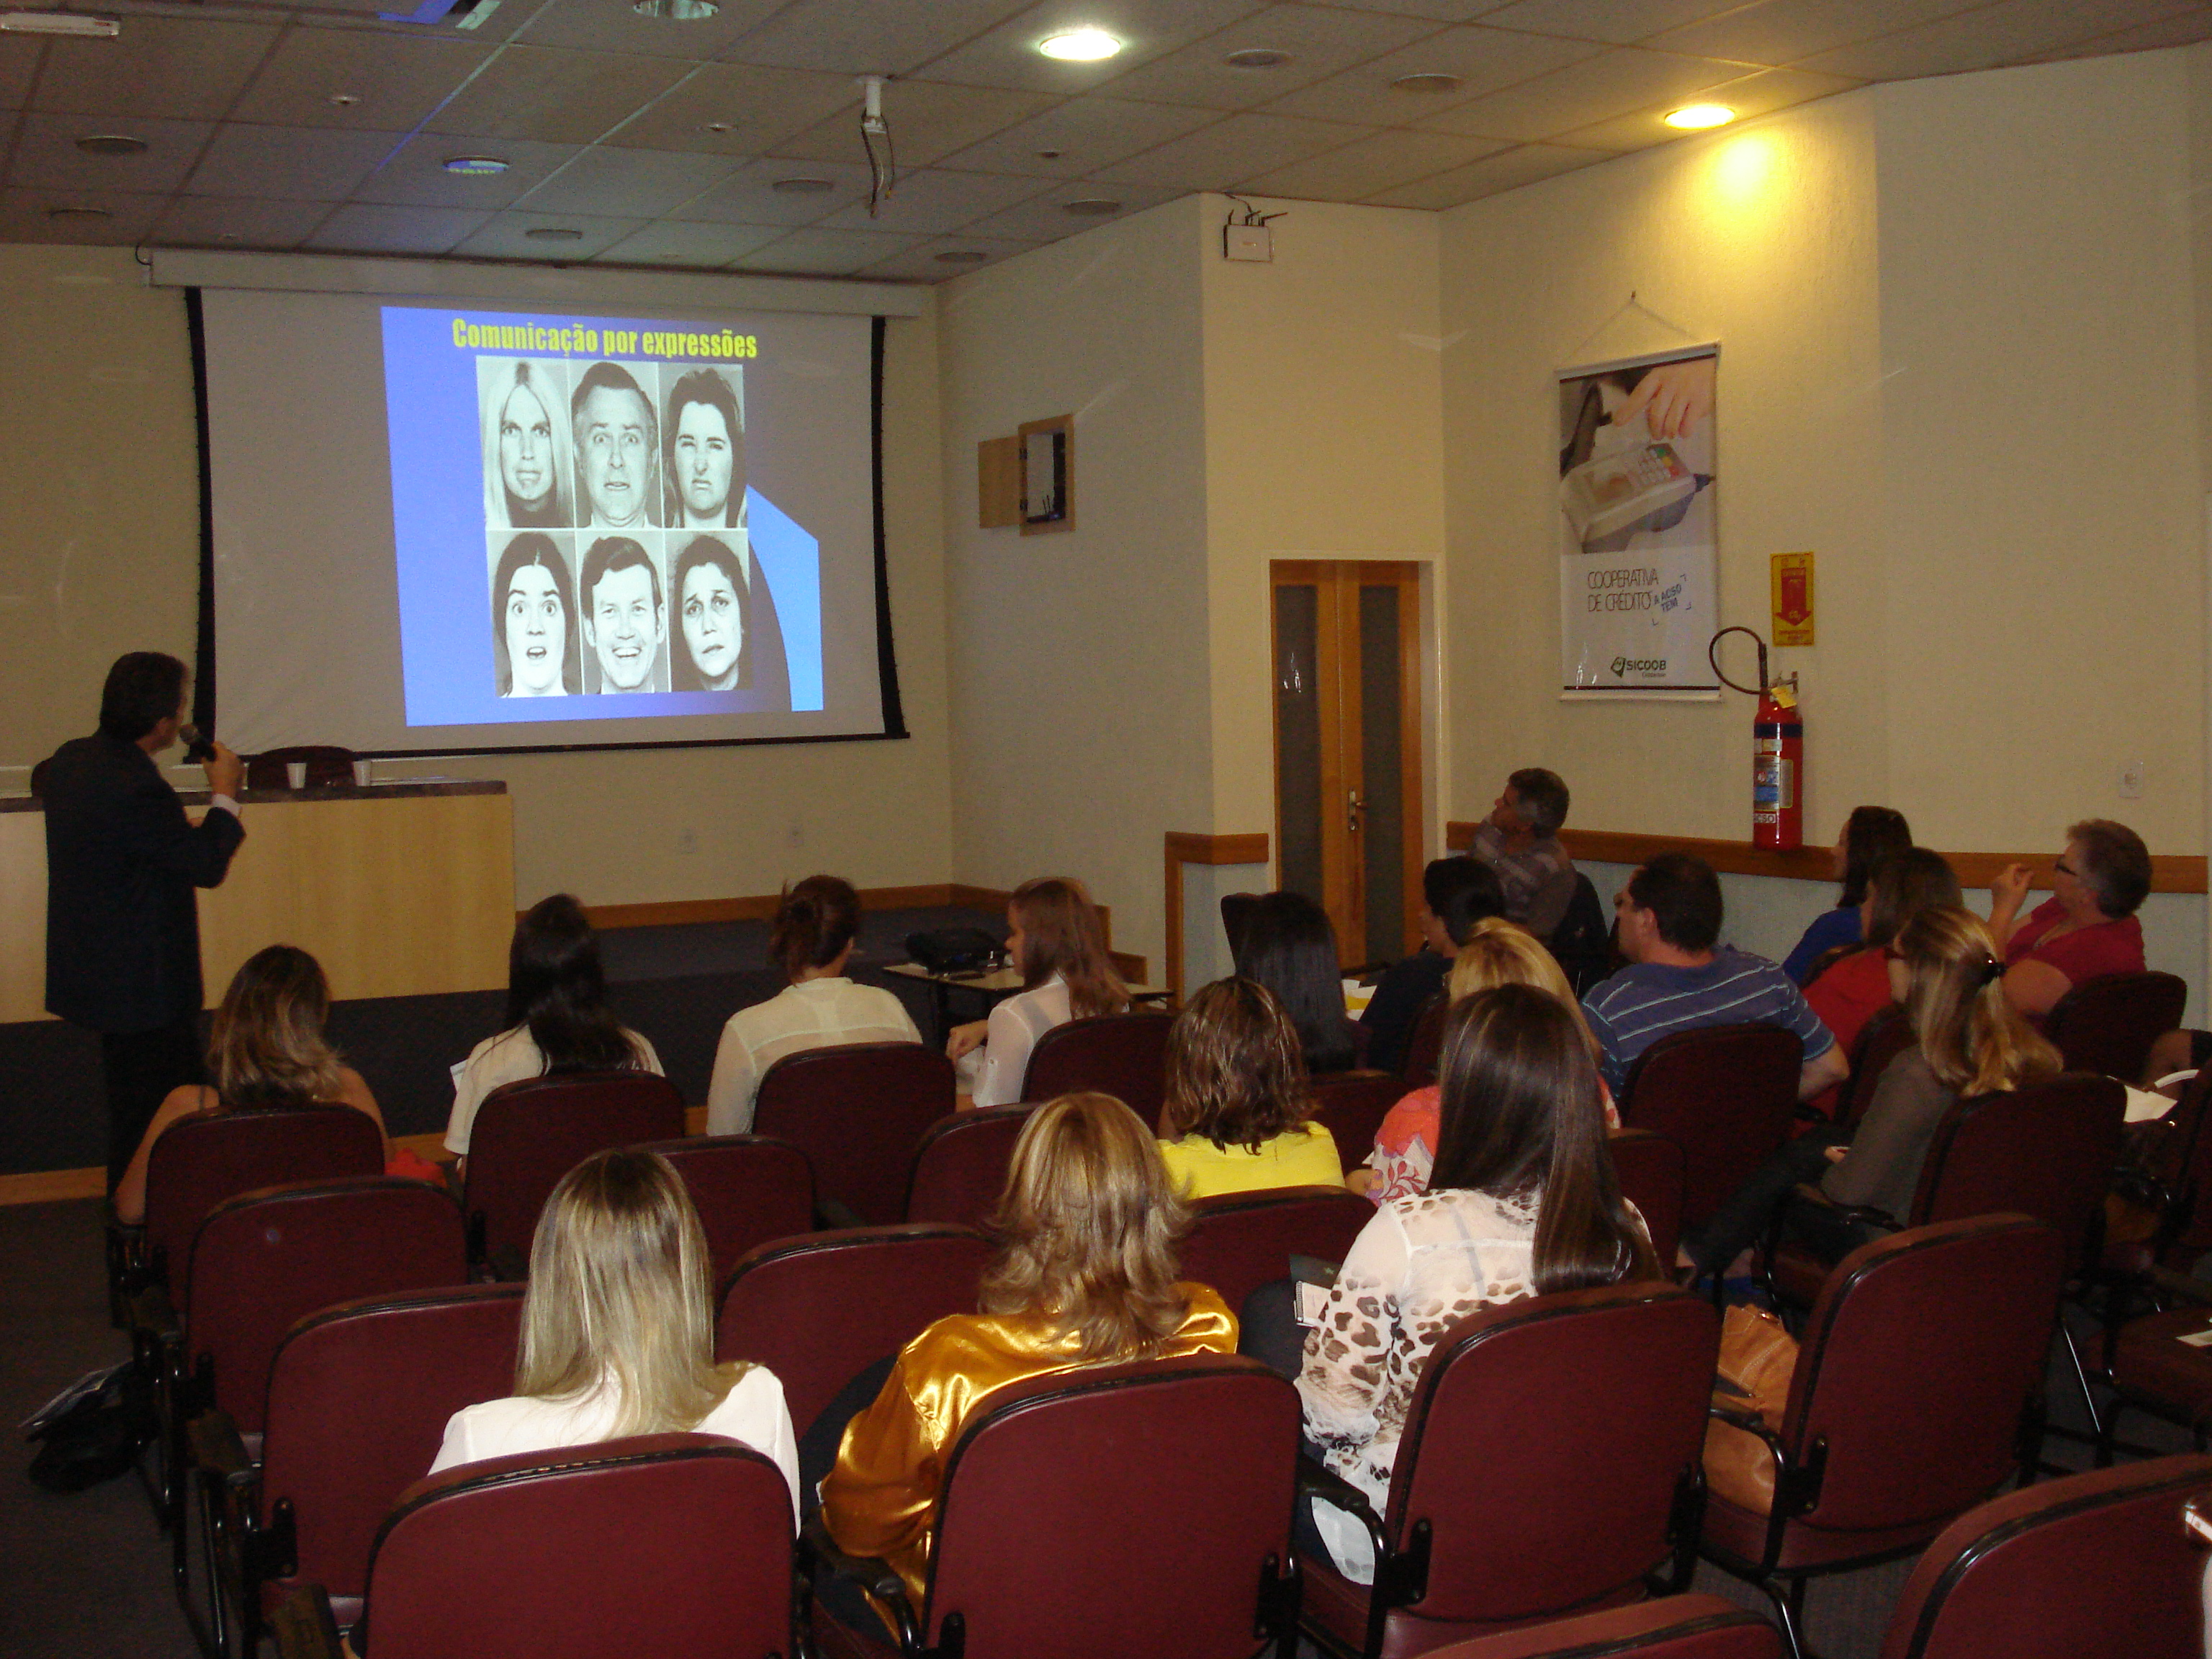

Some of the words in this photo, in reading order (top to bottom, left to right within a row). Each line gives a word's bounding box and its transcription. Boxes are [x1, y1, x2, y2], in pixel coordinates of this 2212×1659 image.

[452, 318, 598, 356] Comunicação
[603, 330, 637, 356] por
[642, 328, 757, 359] expressões
[1588, 568, 1659, 589] COOPERATIVA
[1588, 594, 1603, 611] DE
[1605, 589, 1652, 611] CRÉDITO
[1626, 660, 1667, 670] SICOOB
